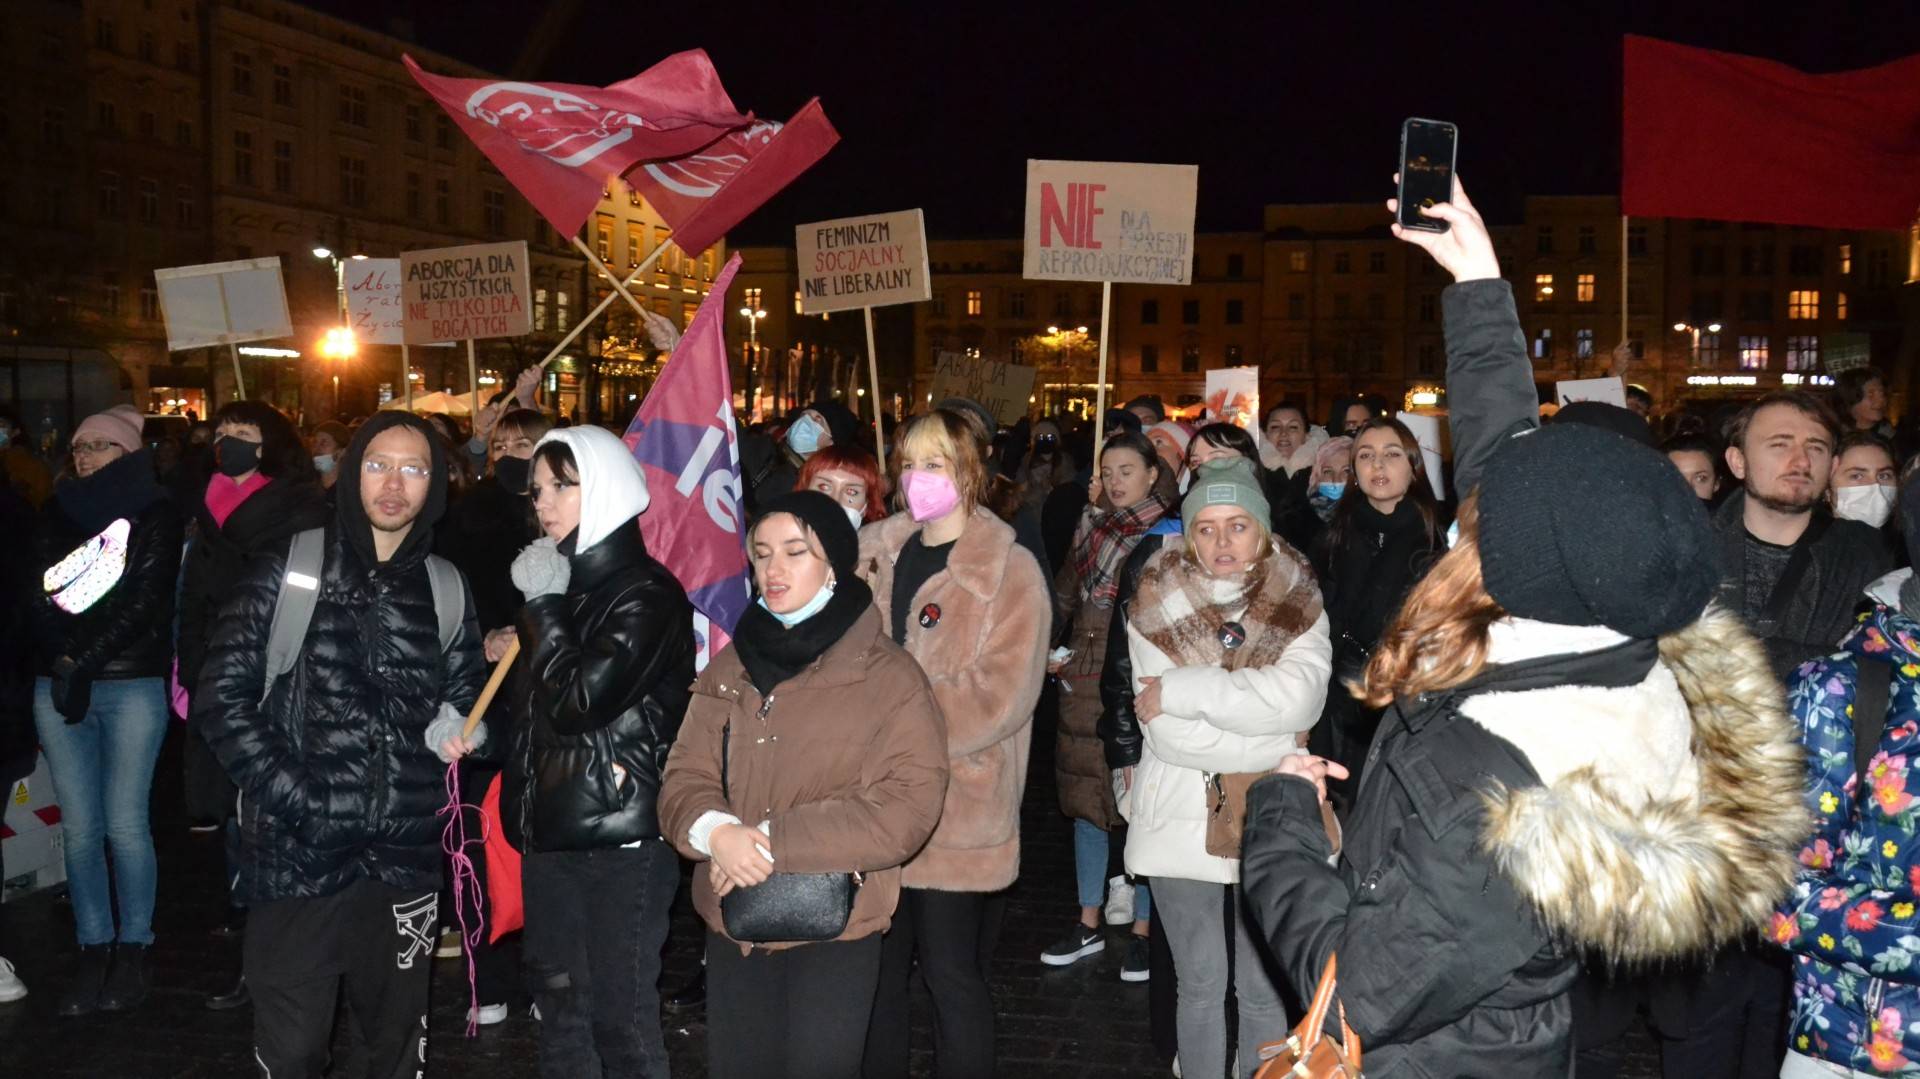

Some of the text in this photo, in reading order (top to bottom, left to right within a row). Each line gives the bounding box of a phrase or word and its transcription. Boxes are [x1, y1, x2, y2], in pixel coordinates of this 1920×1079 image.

[1040, 183, 1151, 249] NIE DLA
[816, 221, 890, 249] FEMINIZM
[408, 254, 515, 282] ABORCJA DLA
[805, 268, 911, 298] NIE LIBERALNY
[409, 294, 522, 321] NIE TYLKO DLA
[432, 316, 508, 339] BOGATYCH
